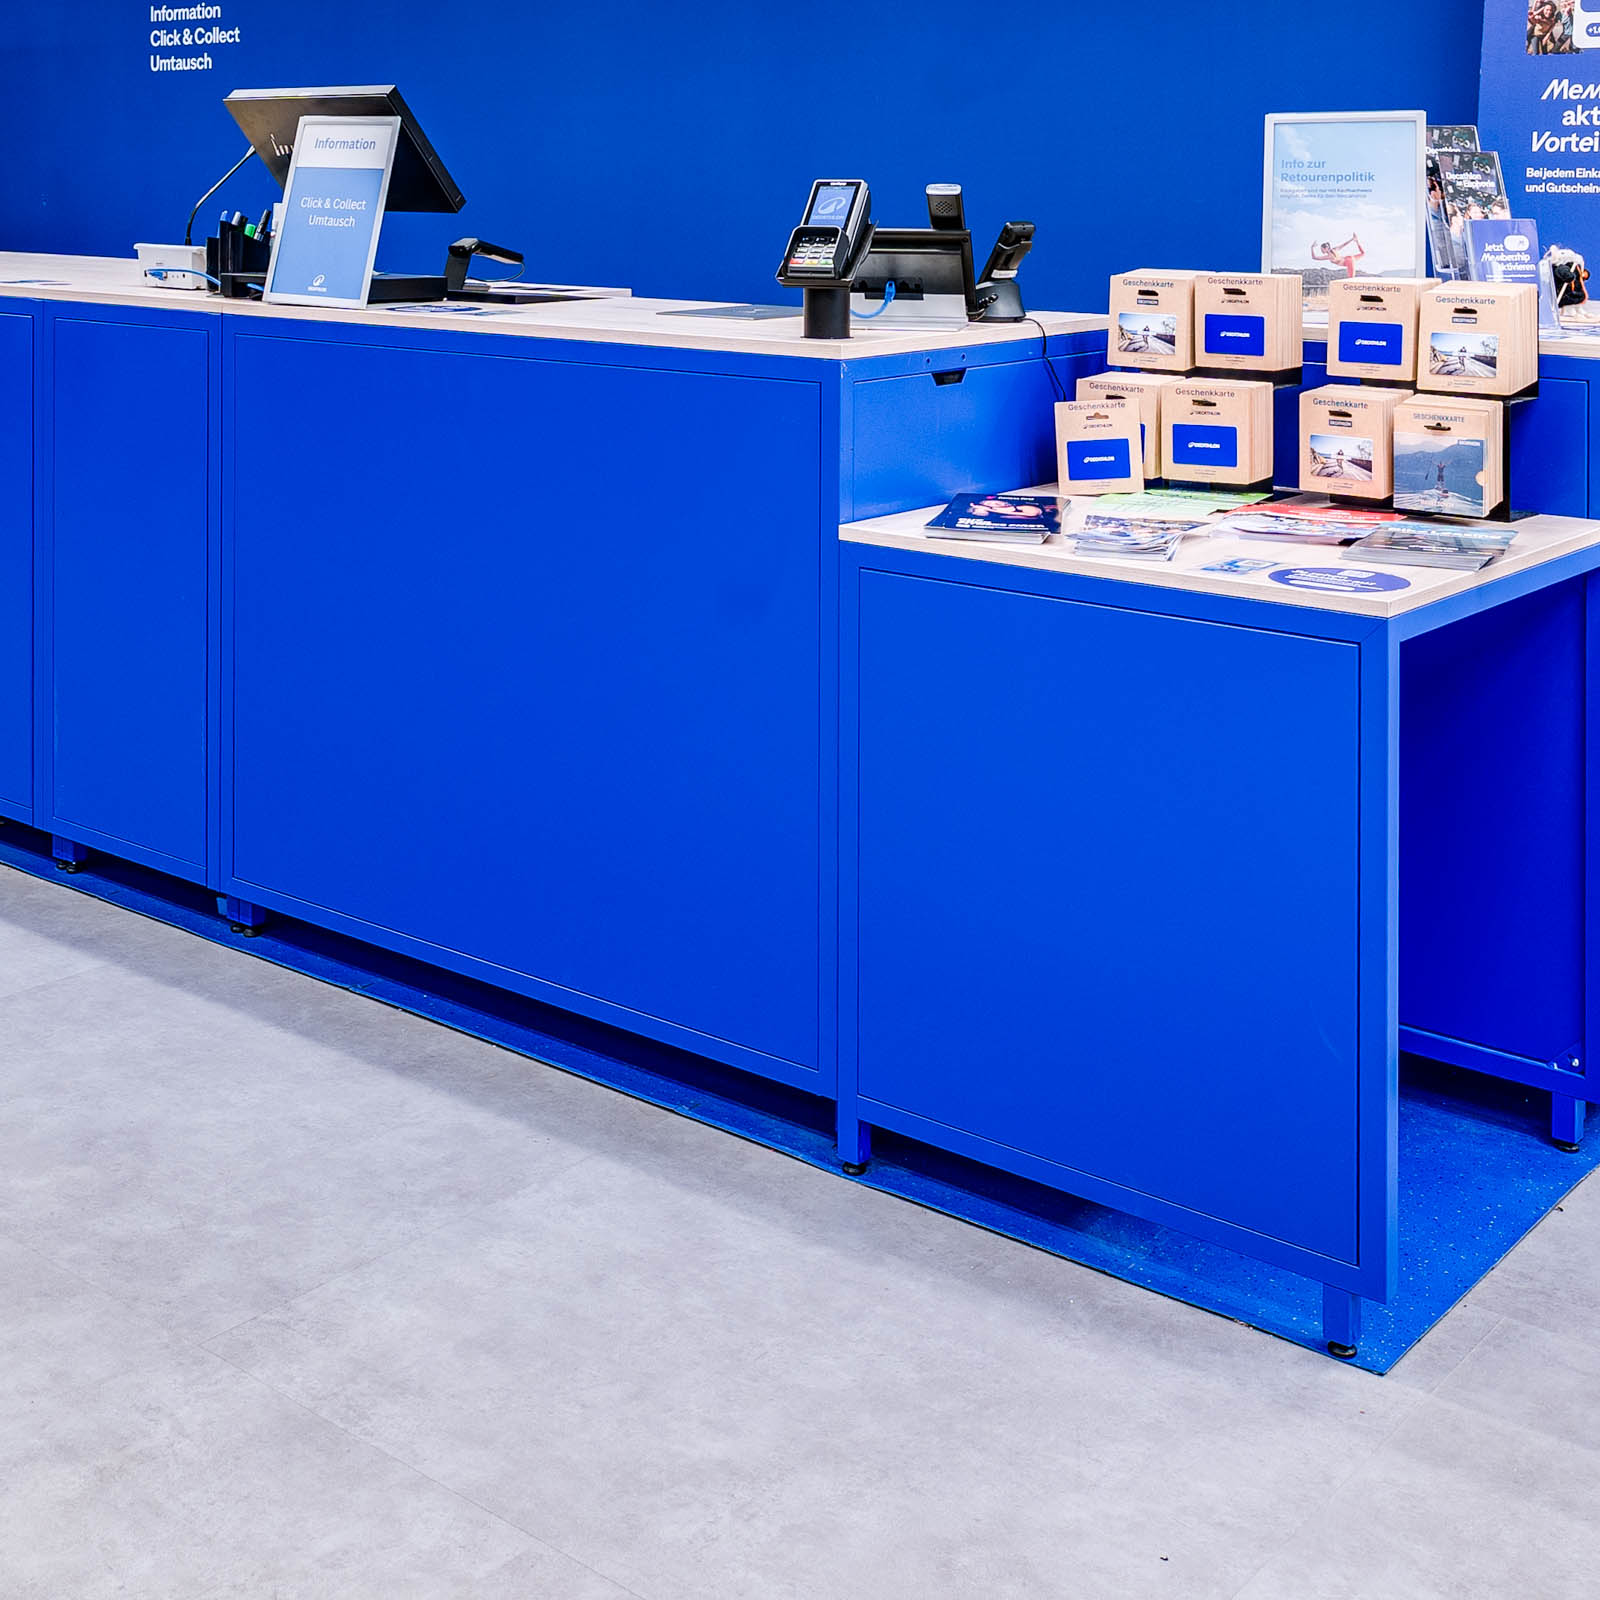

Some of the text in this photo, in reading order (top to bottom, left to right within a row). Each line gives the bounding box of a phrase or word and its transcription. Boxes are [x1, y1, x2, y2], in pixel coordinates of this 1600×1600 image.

[150, 2, 221, 22] Information
[150, 26, 240, 47] Click & Collect
[150, 52, 212, 72] Umtausch
[314, 137, 376, 150] Information
[1281, 160, 1326, 169] Info zur
[1281, 172, 1376, 184] Retourenpolitik
[1446, 172, 1482, 180] Decathlon
[1526, 168, 1542, 179] Bei
[1542, 168, 1575, 181] jedem
[1525, 183, 1545, 193] und
[300, 197, 367, 211] Click & Collect
[308, 215, 355, 228] Umtausch
[1483, 243, 1504, 252] Jetzt
[1481, 253, 1531, 263] Membership
[1122, 279, 1174, 288] Geschenkkarte
[1207, 277, 1263, 286] Geschenkkarte
[1343, 283, 1401, 293] Geschenkkarte
[1435, 296, 1496, 305] Geschenkkarte
[1089, 382, 1144, 394] Geschenkkarte
[1175, 388, 1235, 398] Geschenkkarte
[1067, 401, 1126, 411] Geschenkkarte
[1313, 397, 1368, 409] Geschenkkarte
